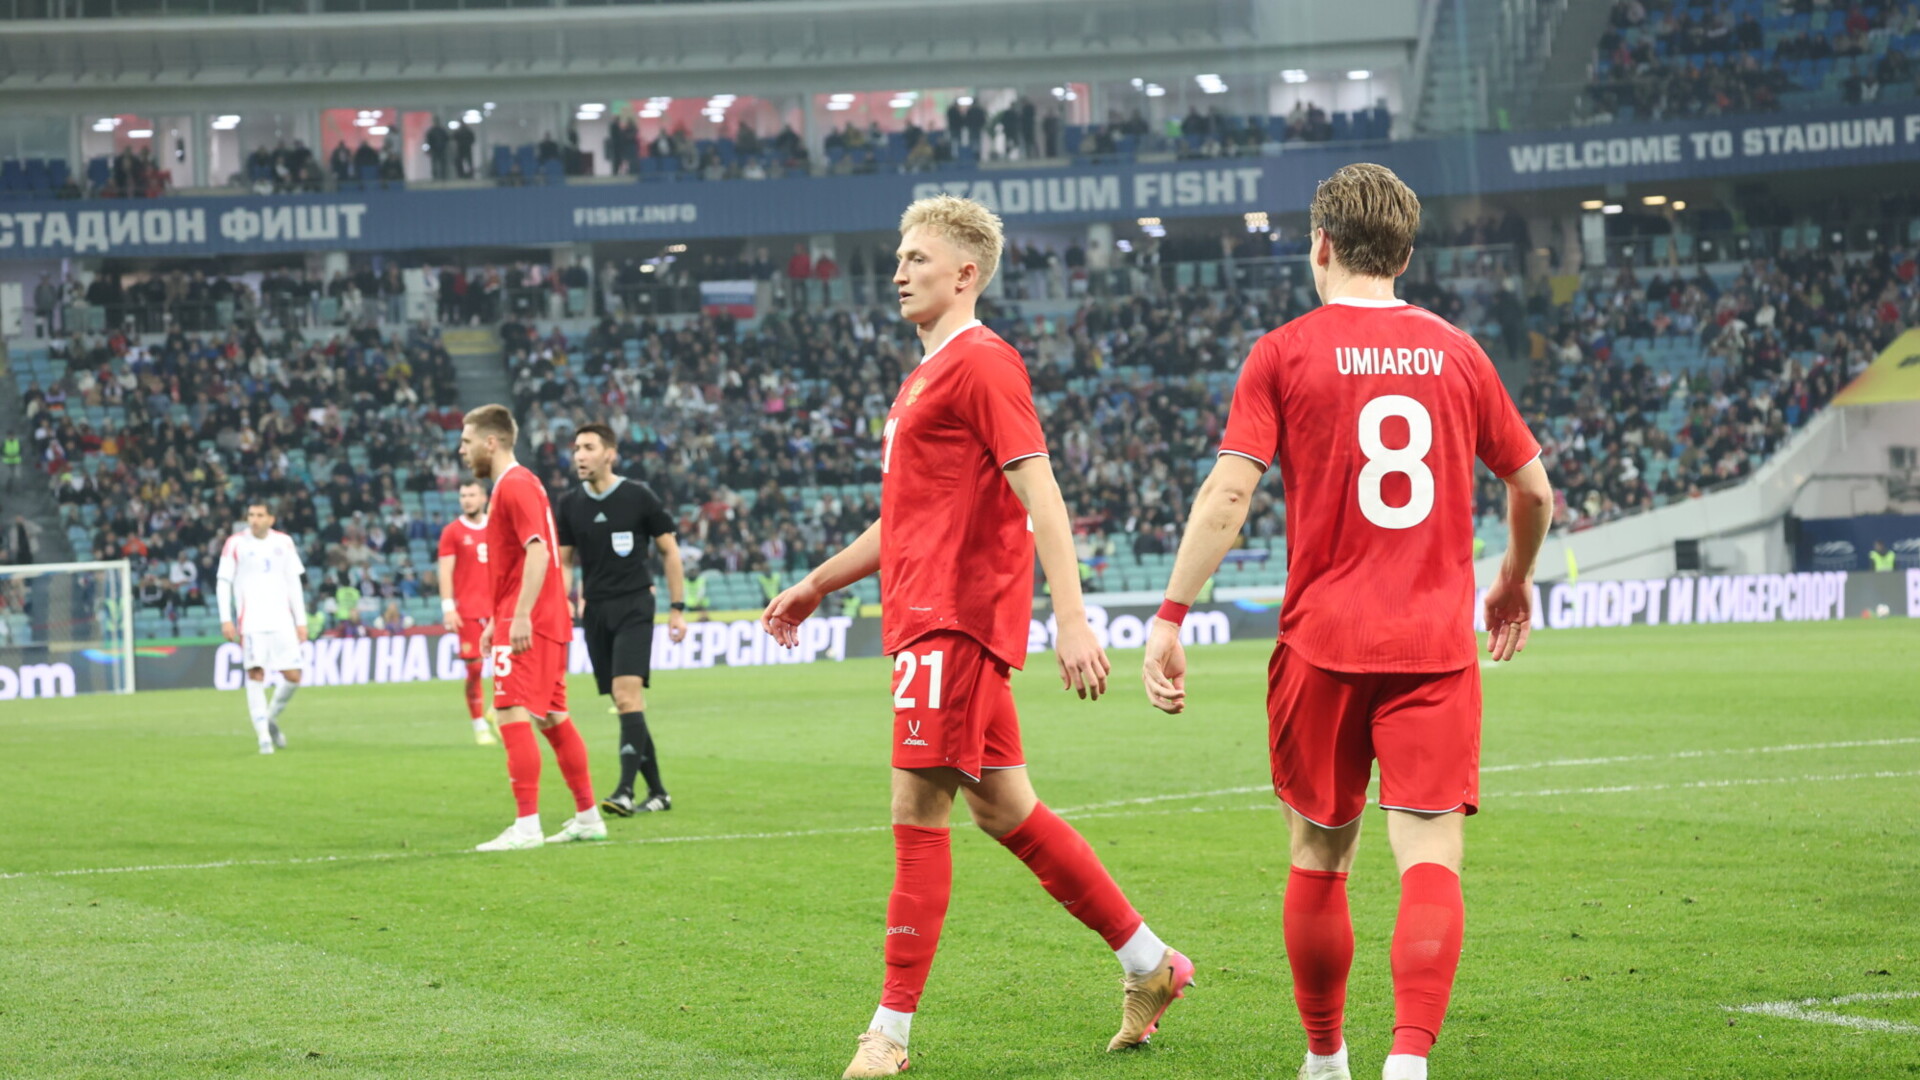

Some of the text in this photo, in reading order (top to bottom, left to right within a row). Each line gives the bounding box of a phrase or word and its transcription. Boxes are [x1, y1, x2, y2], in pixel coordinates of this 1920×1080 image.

[1509, 134, 1682, 173] WELCOME
[1690, 131, 1733, 158] TO
[1743, 117, 1894, 156] STADIUM
[1133, 169, 1262, 209] FISHT
[220, 204, 367, 242] ФИШТ
[573, 204, 697, 226] FISHT.INFO
[1335, 347, 1444, 376] UMIAROV
[1358, 394, 1435, 529] 8
[1549, 578, 1667, 629] СПОРТ
[1667, 576, 1694, 625] И
[1696, 570, 1848, 624] КИБЕРСПОРТ
[374, 634, 431, 683] НА
[893, 650, 944, 709] 21
